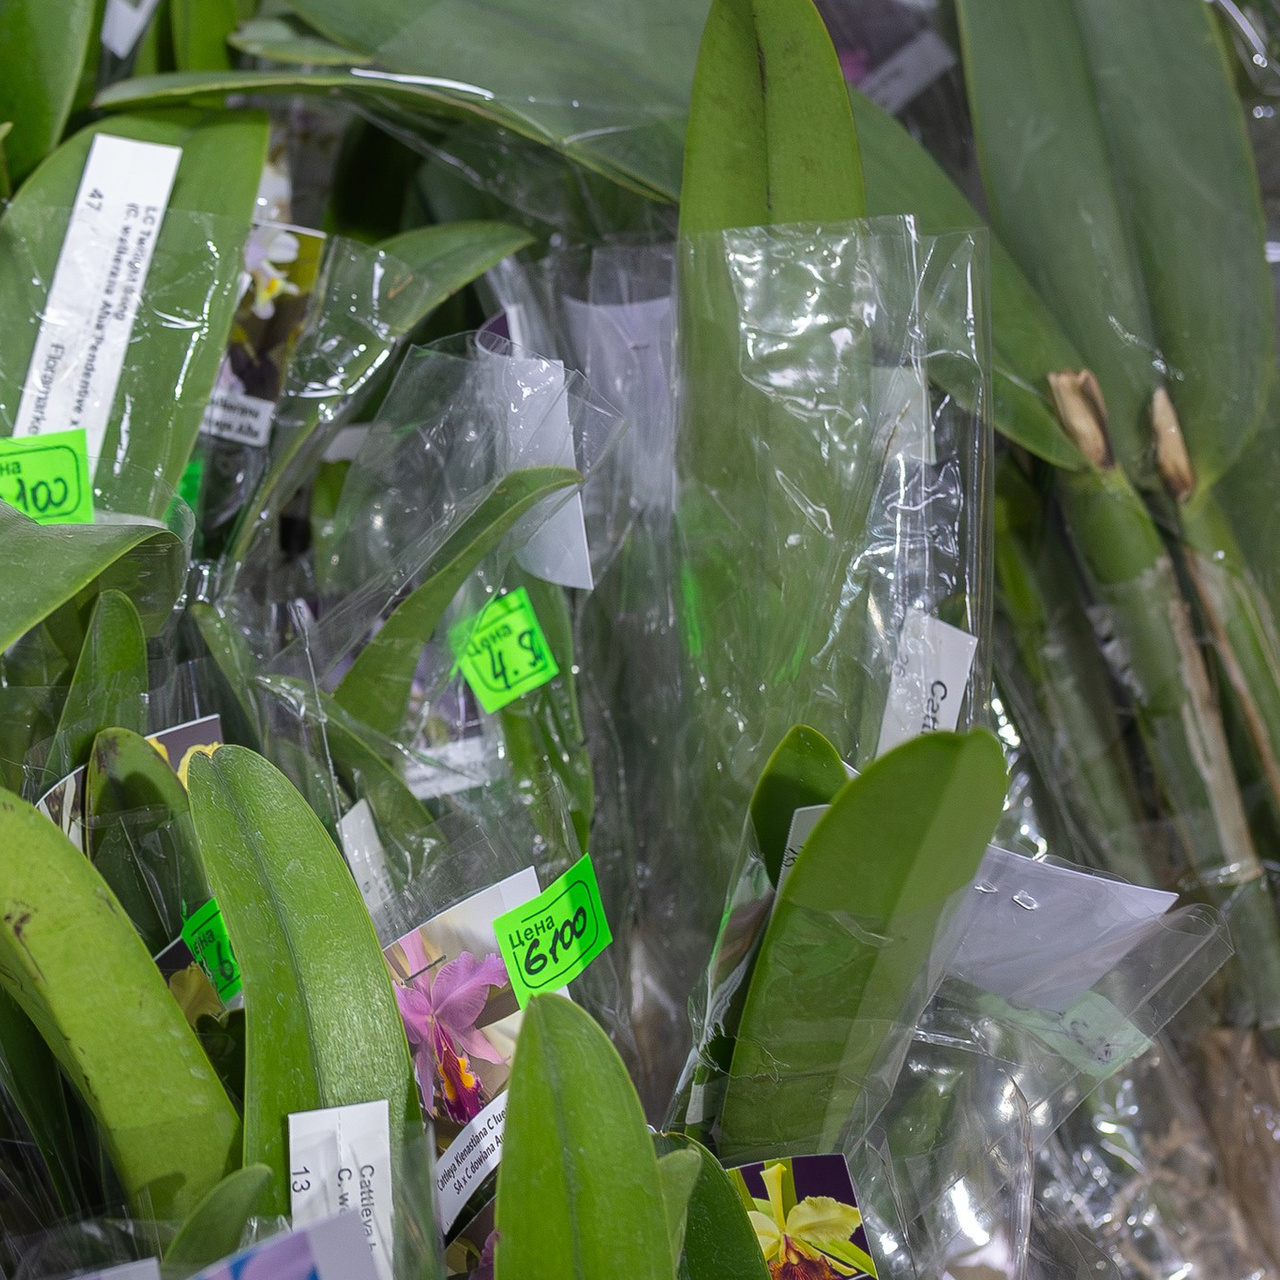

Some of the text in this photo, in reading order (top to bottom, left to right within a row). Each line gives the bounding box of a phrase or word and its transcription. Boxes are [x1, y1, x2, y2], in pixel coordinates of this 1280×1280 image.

[86, 187, 105, 212] 47
[508, 914, 556, 951] Цена
[523, 905, 588, 976] 6100
[436, 1162, 458, 1192] Cattleya
[453, 1126, 489, 1168] Kienastiana
[453, 1178, 465, 1195] SA
[469, 1142, 496, 1175] dowiana
[291, 1165, 312, 1195] 13
[336, 1167, 354, 1189] C.
